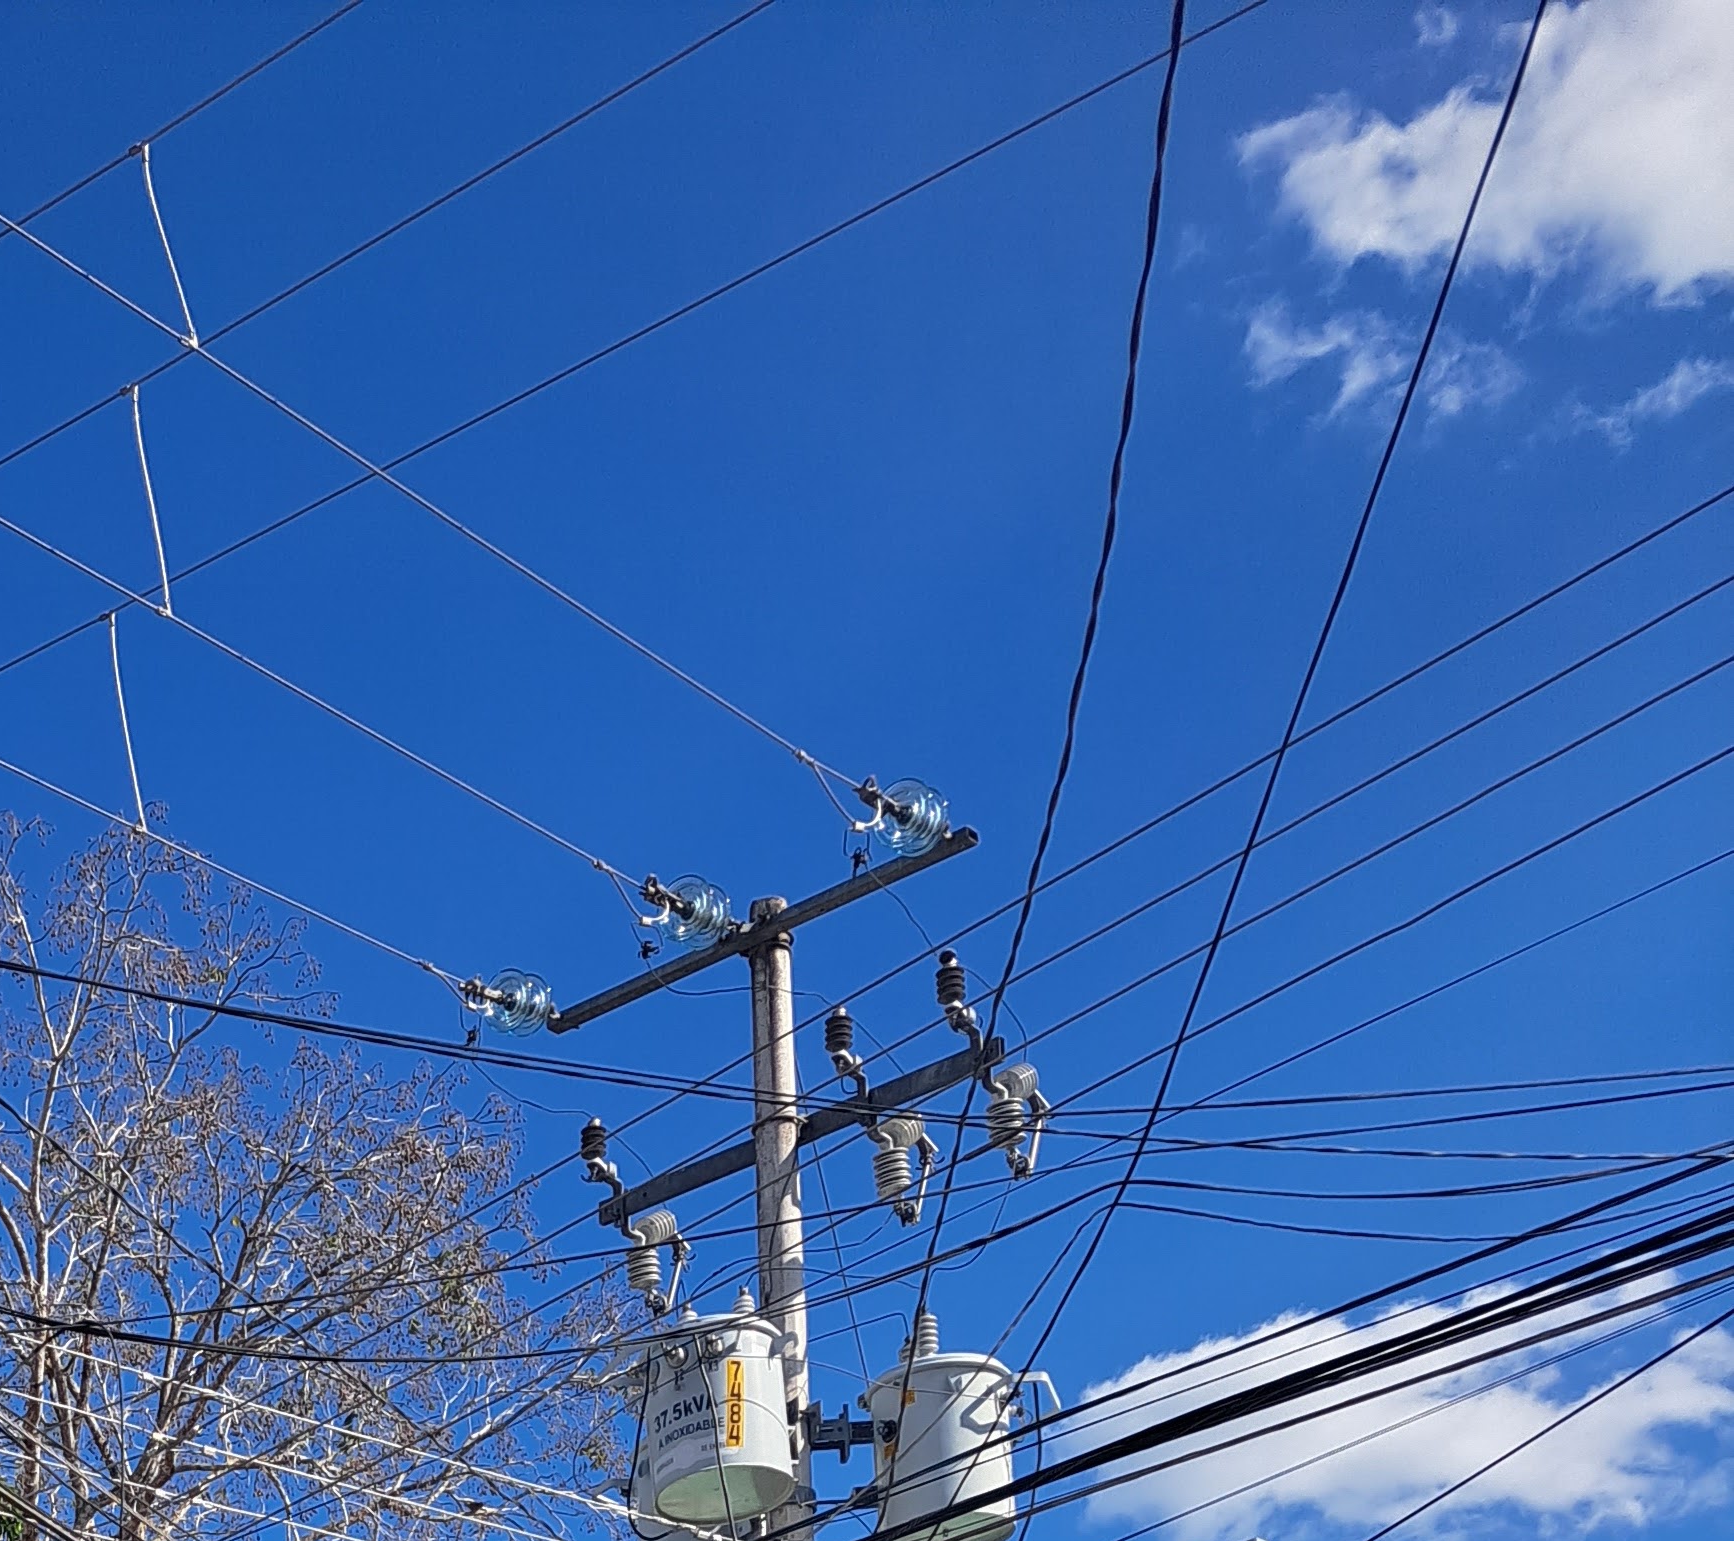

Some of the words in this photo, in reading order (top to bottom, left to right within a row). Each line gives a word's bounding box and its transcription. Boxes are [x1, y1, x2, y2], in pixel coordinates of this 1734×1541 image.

[653, 1393, 719, 1434] 37.5kVA
[728, 1361, 742, 1446] 7484
[666, 1416, 725, 1447] INOXIDABLE
